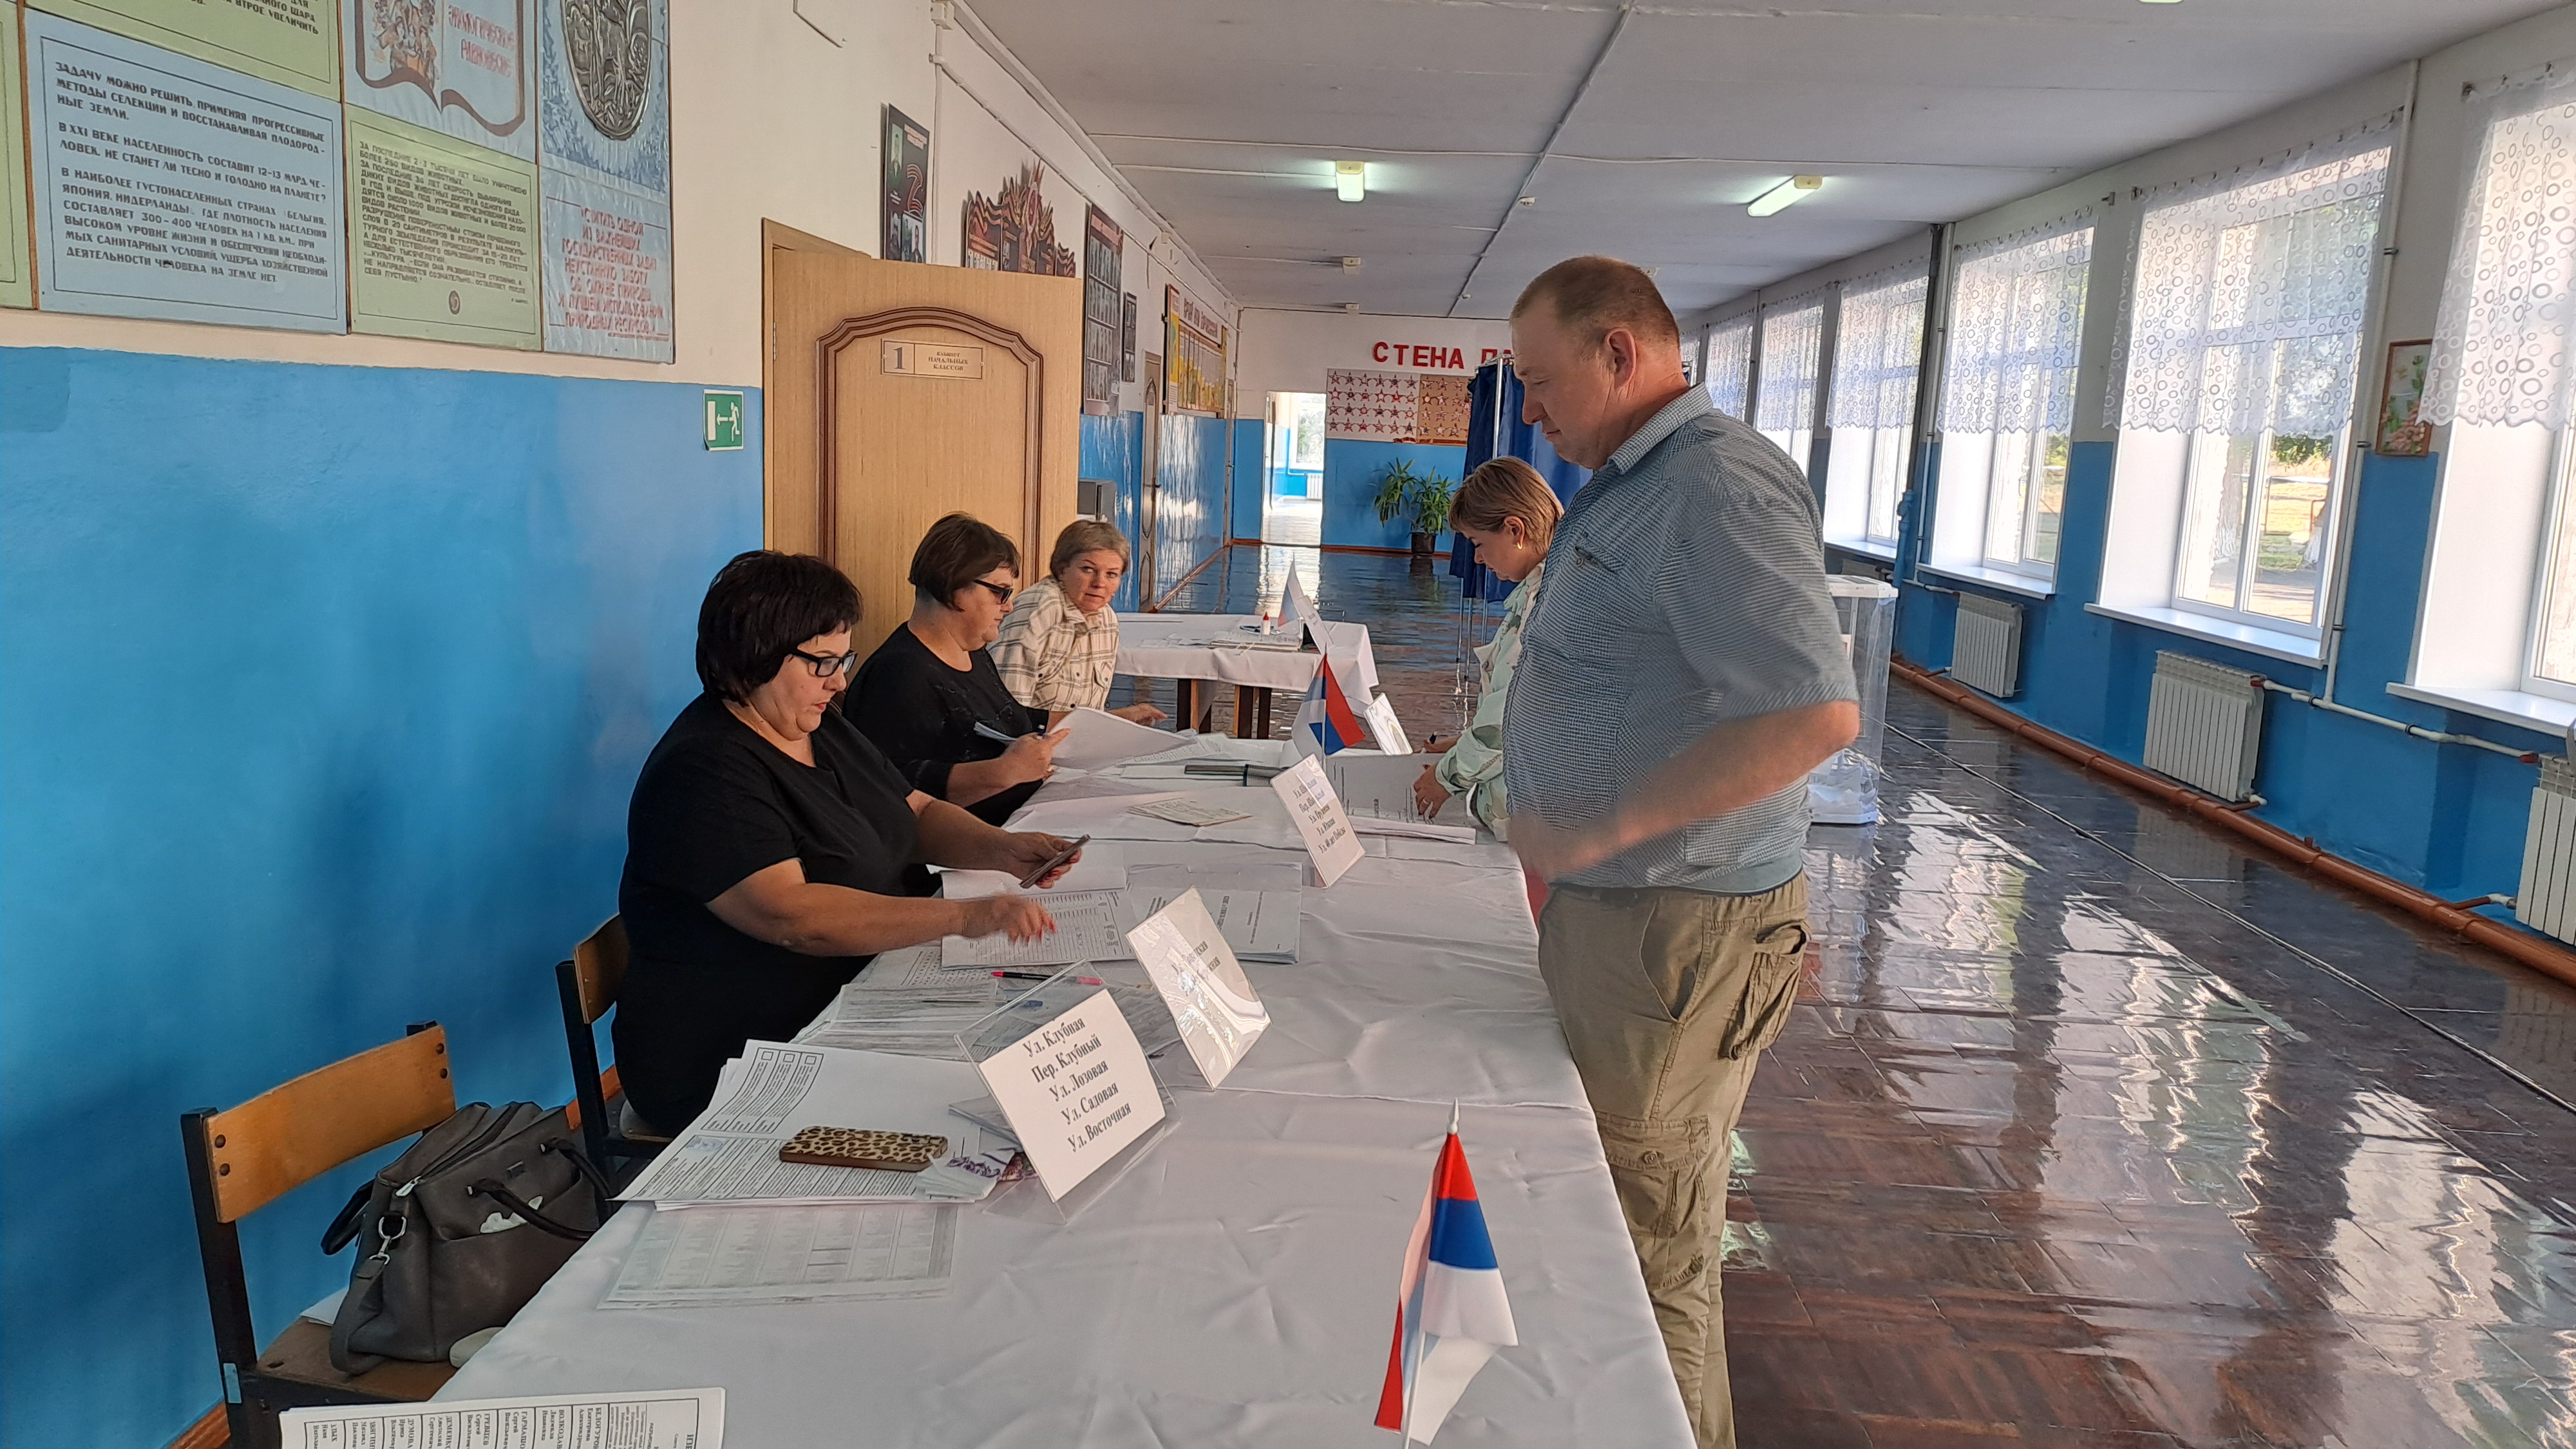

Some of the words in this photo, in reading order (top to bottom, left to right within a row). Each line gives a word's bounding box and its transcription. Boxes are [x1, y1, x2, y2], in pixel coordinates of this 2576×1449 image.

[268, 9, 319, 35] УВЕЛИЧИТЬ
[290, 6, 316, 23] ШАРА
[55, 61, 101, 81] ЗАДАЧУ
[106, 75, 147, 93] МОЖНО
[197, 100, 246, 121] ПРИМЕНЯЯ
[251, 115, 324, 142] ПРОГРЕССИВНЫЕ
[56, 77, 106, 99] МЕТОДЫ
[110, 92, 167, 114] СЕЛЕКЦИИ
[170, 108, 178, 117] И
[182, 110, 267, 140] ВОССТАНАВЛИВАЯ
[57, 93, 83, 109] НЫЕ
[58, 121, 66, 132] В
[69, 124, 88, 137] XXI
[91, 129, 118, 144] ВЕКЕ
[123, 136, 204, 162] НАСЕЛЕННОСТЬ
[207, 155, 254, 173] СОСТАВИТ
[61, 167, 69, 176] В
[74, 169, 131, 188] НАИБОЛЕЕ
[136, 180, 232, 207] ГУСТОНАСЕЛЕННЫХ
[237, 200, 276, 215] СТРАНАХ
[104, 148, 118, 160] НЕ
[122, 152, 160, 168] СТАНЕТ
[162, 161, 176, 172] ЛИ
[180, 164, 211, 178] ТЕСНО
[214, 172, 221, 181] И
[225, 174, 267, 190] ГОЛОДНО
[269, 184, 281, 194] НА
[63, 200, 133, 219] СОСТАВЛЯЕТ
[194, 221, 238, 236] ЧЕЛОВЕК
[241, 229, 253, 238] НА
[298, 238, 314, 249] ПРИ
[64, 214, 122, 231] ВЫСОКОМ
[126, 224, 167, 239] УРОВНЕ
[171, 231, 206, 245] ЖИЗНИ
[210, 237, 217, 246] И
[202, 208, 218, 219] ГДЕ
[223, 212, 276, 229] ПЛОТНОСТЬ
[65, 230, 93, 242] МЫХ
[96, 234, 167, 253] САНИТАРНЫХ
[66, 246, 151, 265] ДЕЯТЕЛЬНОСТИ
[211, 265, 224, 276] НА
[894, 346, 905, 370] 1
[1372, 341, 1464, 369] СТЕНА
[1023, 1041, 1045, 1057] Ул.
[1043, 1017, 1086, 1047] Клубная
[1031, 1064, 1058, 1084] Пер.
[1056, 1034, 1102, 1065] Клубный
[1049, 1084, 1070, 1102] Ул.
[1068, 1059, 1108, 1091] Лозовая
[1061, 1107, 1082, 1124] Ул.
[1081, 1082, 1119, 1113] Садовая
[1067, 1134, 1087, 1153] Ул.
[1084, 1101, 1132, 1141] Восточная
